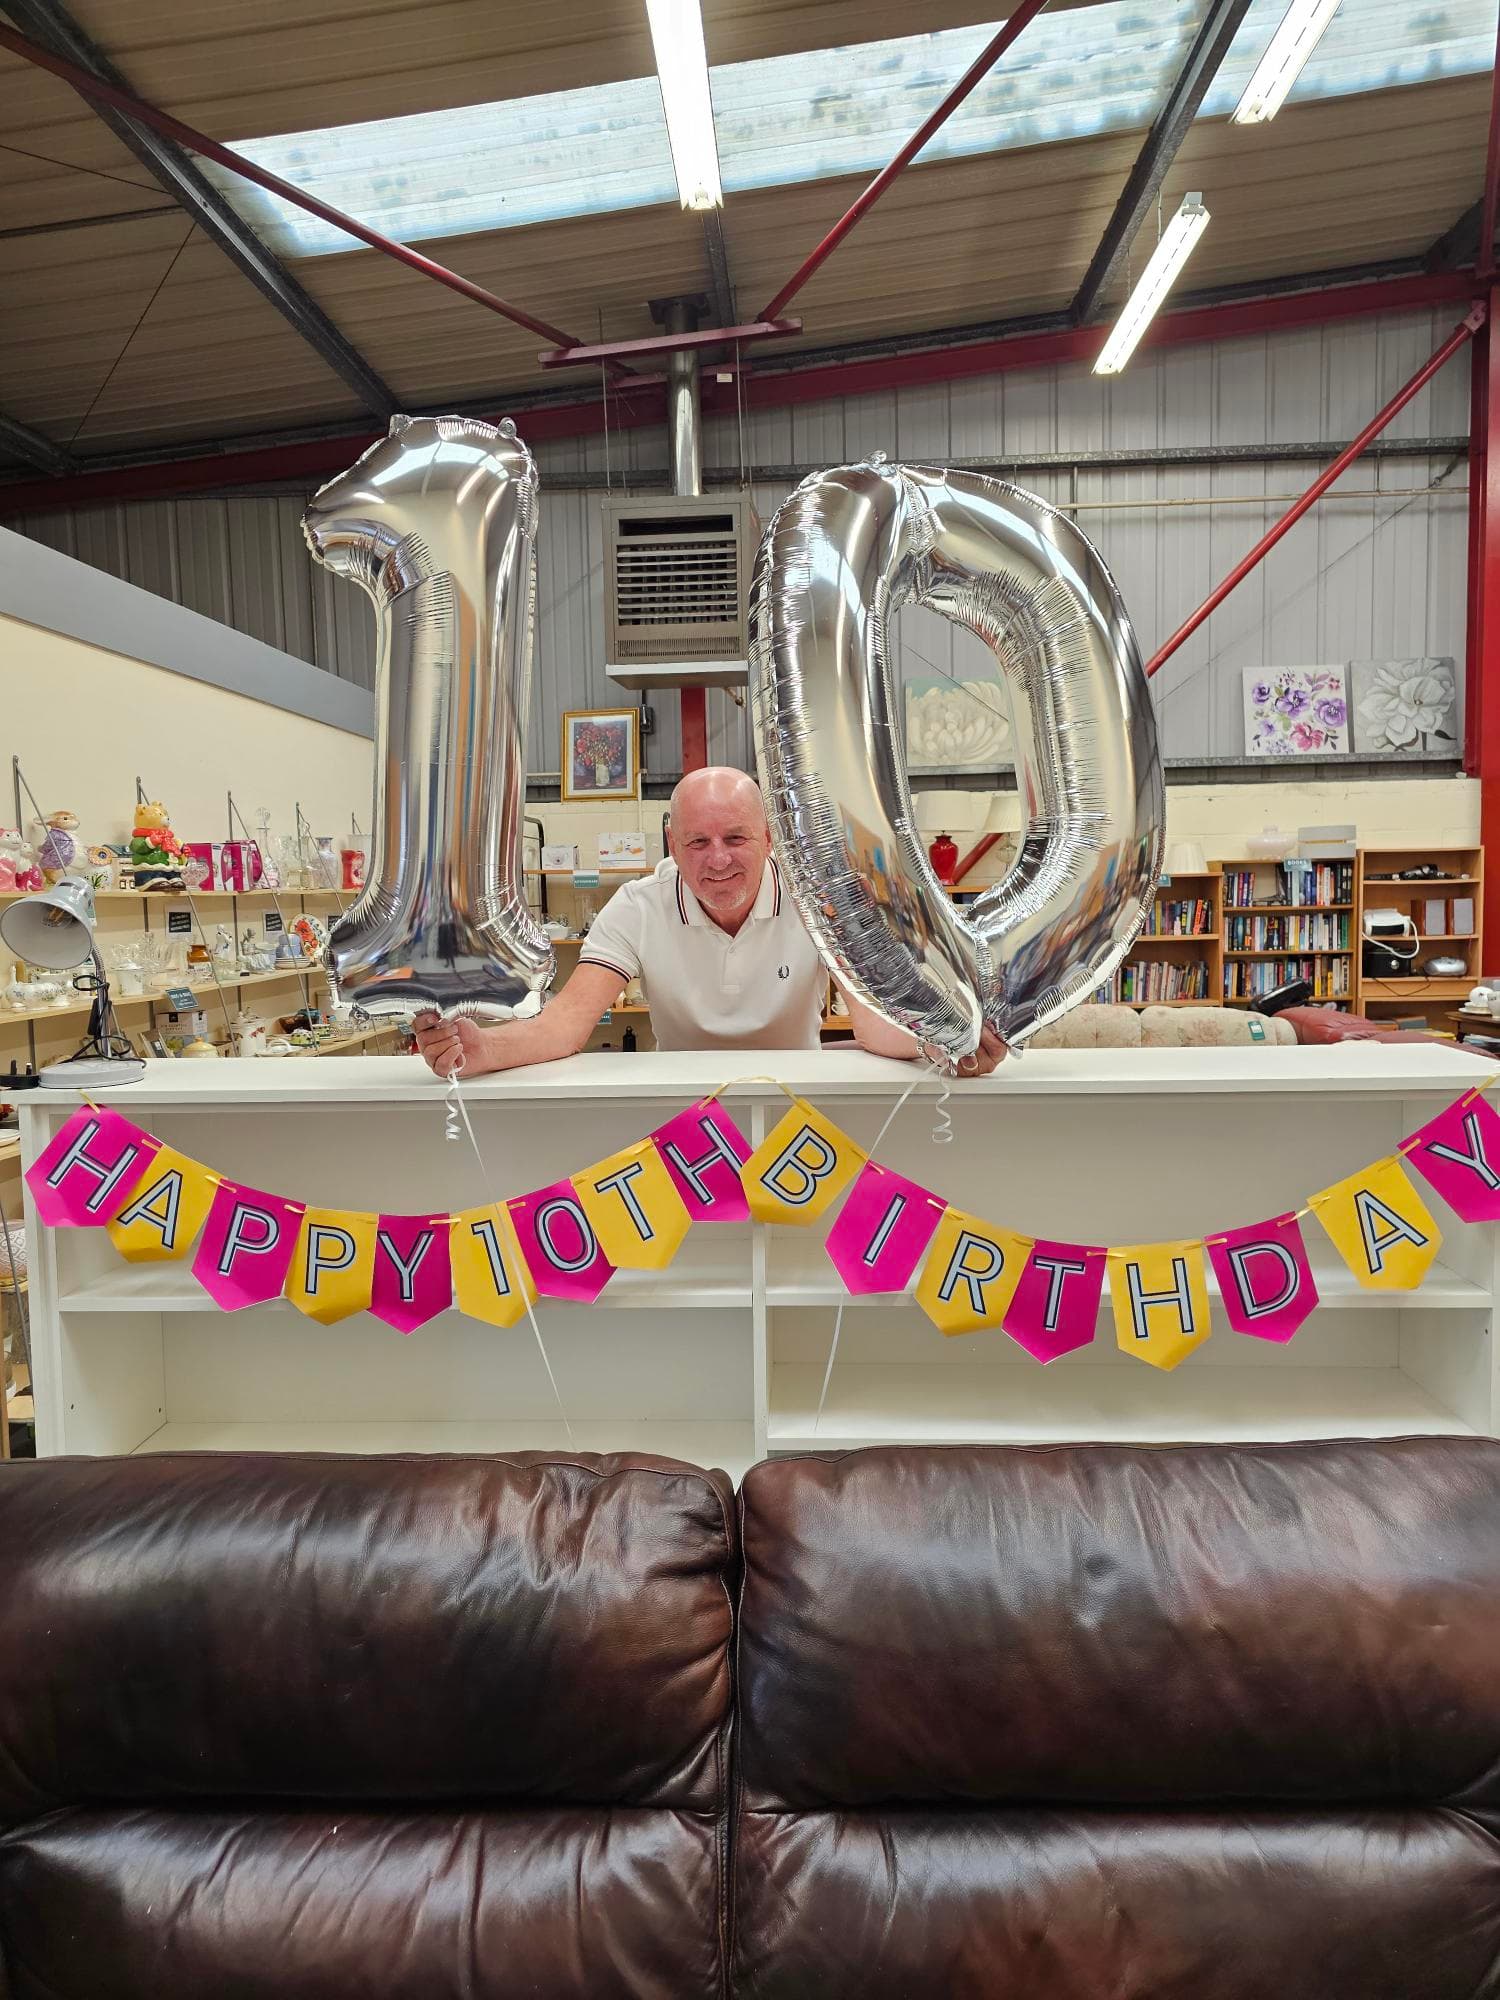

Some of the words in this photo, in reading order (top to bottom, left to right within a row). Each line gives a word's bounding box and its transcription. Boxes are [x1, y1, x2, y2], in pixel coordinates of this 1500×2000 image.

[46, 1119, 434, 1302] HAPPY
[471, 1116, 743, 1297] 10TH
[760, 1111, 1500, 1338] BIRTHDAY
